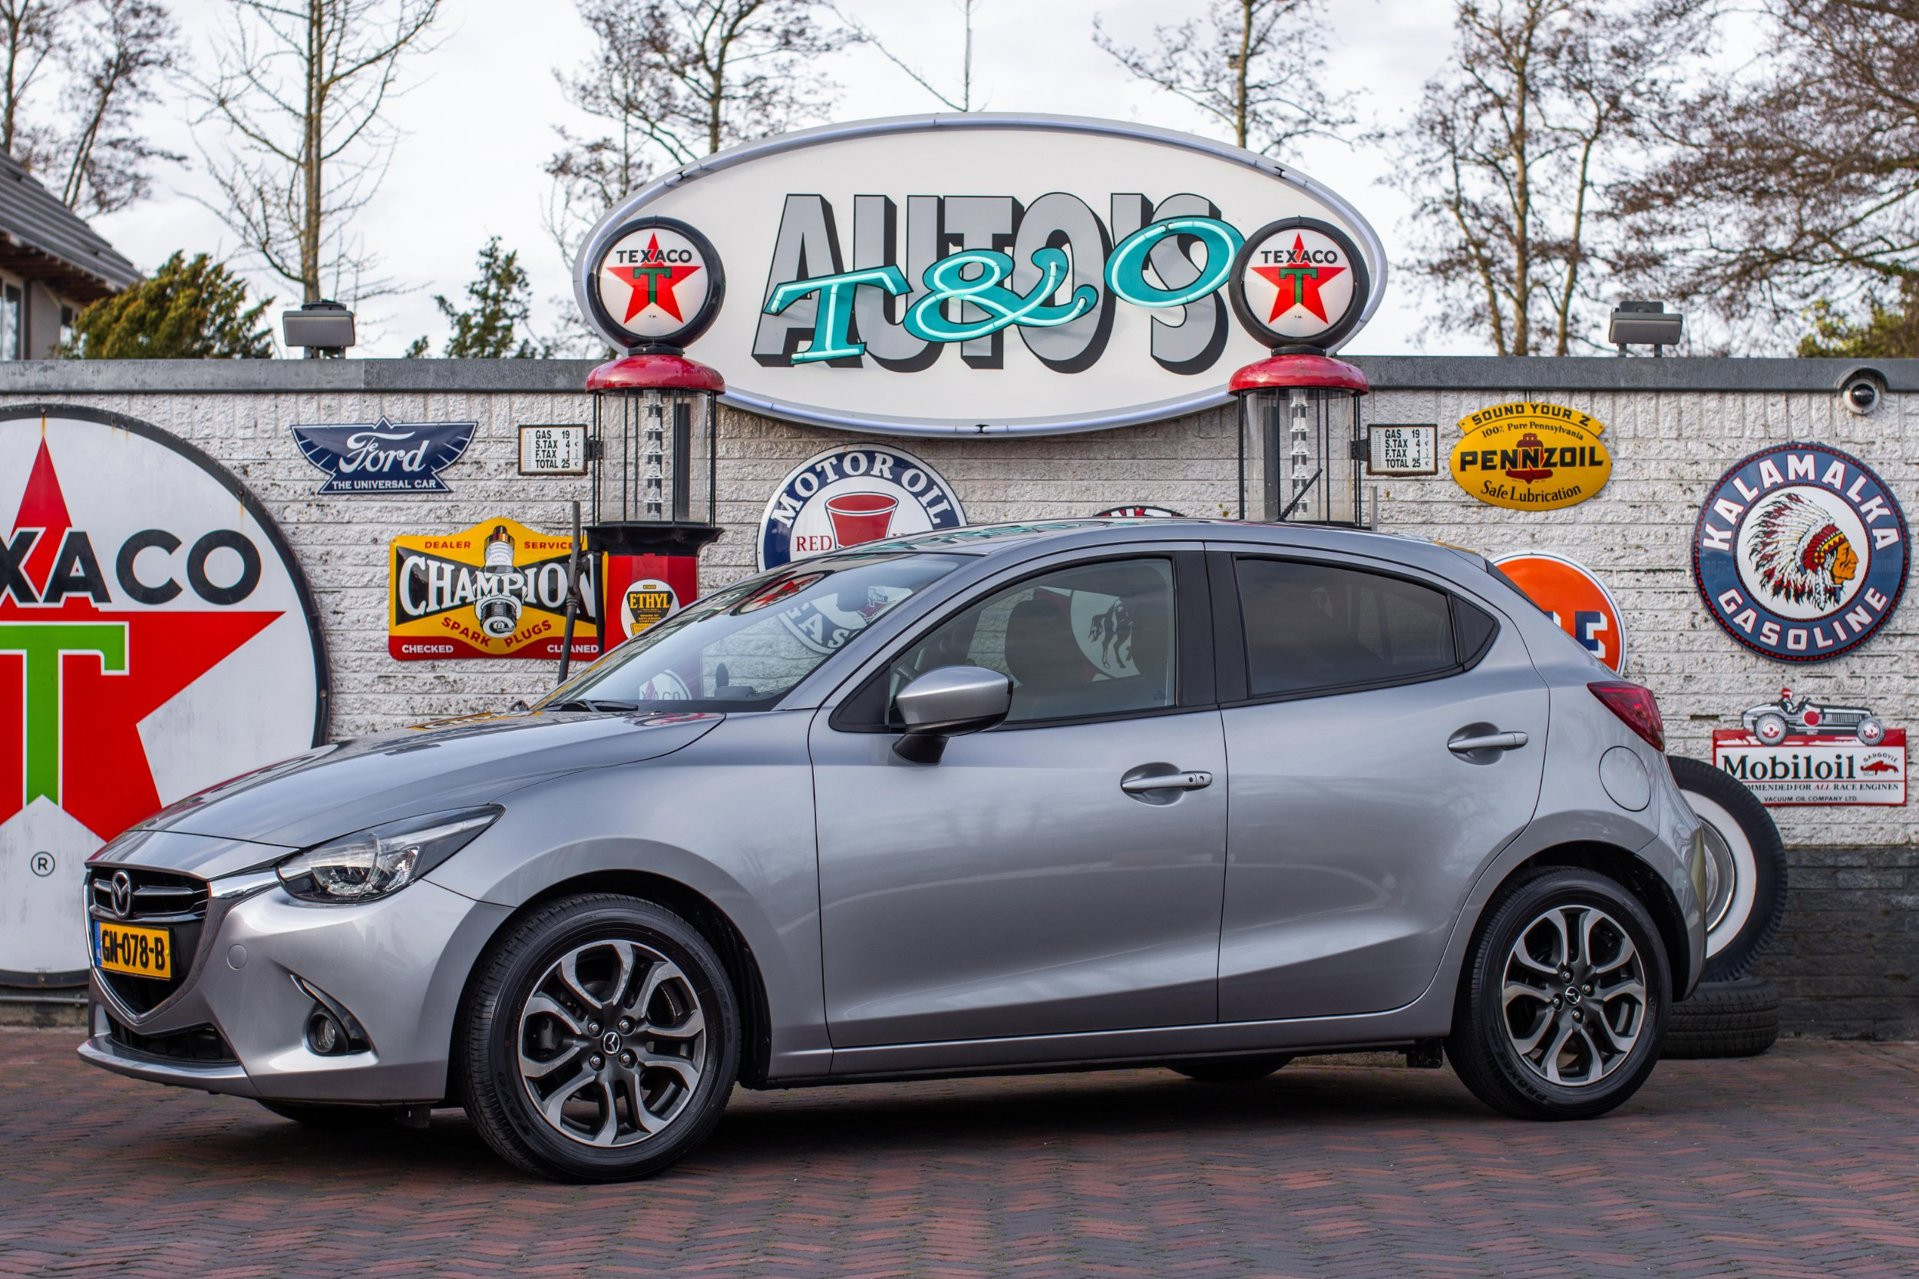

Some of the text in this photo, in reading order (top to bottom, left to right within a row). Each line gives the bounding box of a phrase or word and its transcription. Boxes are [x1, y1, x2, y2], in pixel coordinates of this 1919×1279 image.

[616, 249, 692, 263] TEXACO
[1261, 250, 1338, 264] TEXACO
[752, 192, 1228, 375] AUTO'S
[1471, 403, 1592, 427] SOUND YOUR Z
[535, 430, 552, 440] GAS
[561, 430, 571, 440] 19
[1385, 429, 1402, 439] GAS
[1411, 429, 1420, 438] 19
[1507, 422, 1528, 432] Pure
[1529, 421, 1584, 441] Pennsylvania
[535, 440, 558, 449] S.TAX
[565, 440, 571, 448] 4
[1385, 439, 1409, 448] S.TAX
[1415, 439, 1421, 448] 4
[338, 431, 427, 474] Ford
[535, 450, 557, 459] F.TAX
[1385, 449, 1407, 458] F.TAX
[1459, 446, 1605, 472] PENNZOIL
[535, 459, 559, 469] TOTAL
[561, 459, 571, 469] 25
[1385, 459, 1410, 468] TOTAL
[1411, 459, 1421, 468] 25
[331, 479, 437, 490] THE UNIVERSAL CAR
[770, 452, 952, 528] MOTOR OIL
[1480, 480, 1582, 503] Safe Lubrication
[1702, 453, 1900, 551] KALAMALKA
[424, 541, 472, 549] DEALER
[796, 535, 833, 552] RED
[629, 593, 670, 609] ETHYL
[1717, 587, 1888, 651] GASOLINE
[441, 616, 552, 648] SPARK PLUGS
[401, 644, 599, 654] CHECKED CLANED
[1722, 753, 1856, 780] Mobiloil
[1860, 783, 1899, 791] ENGINES
